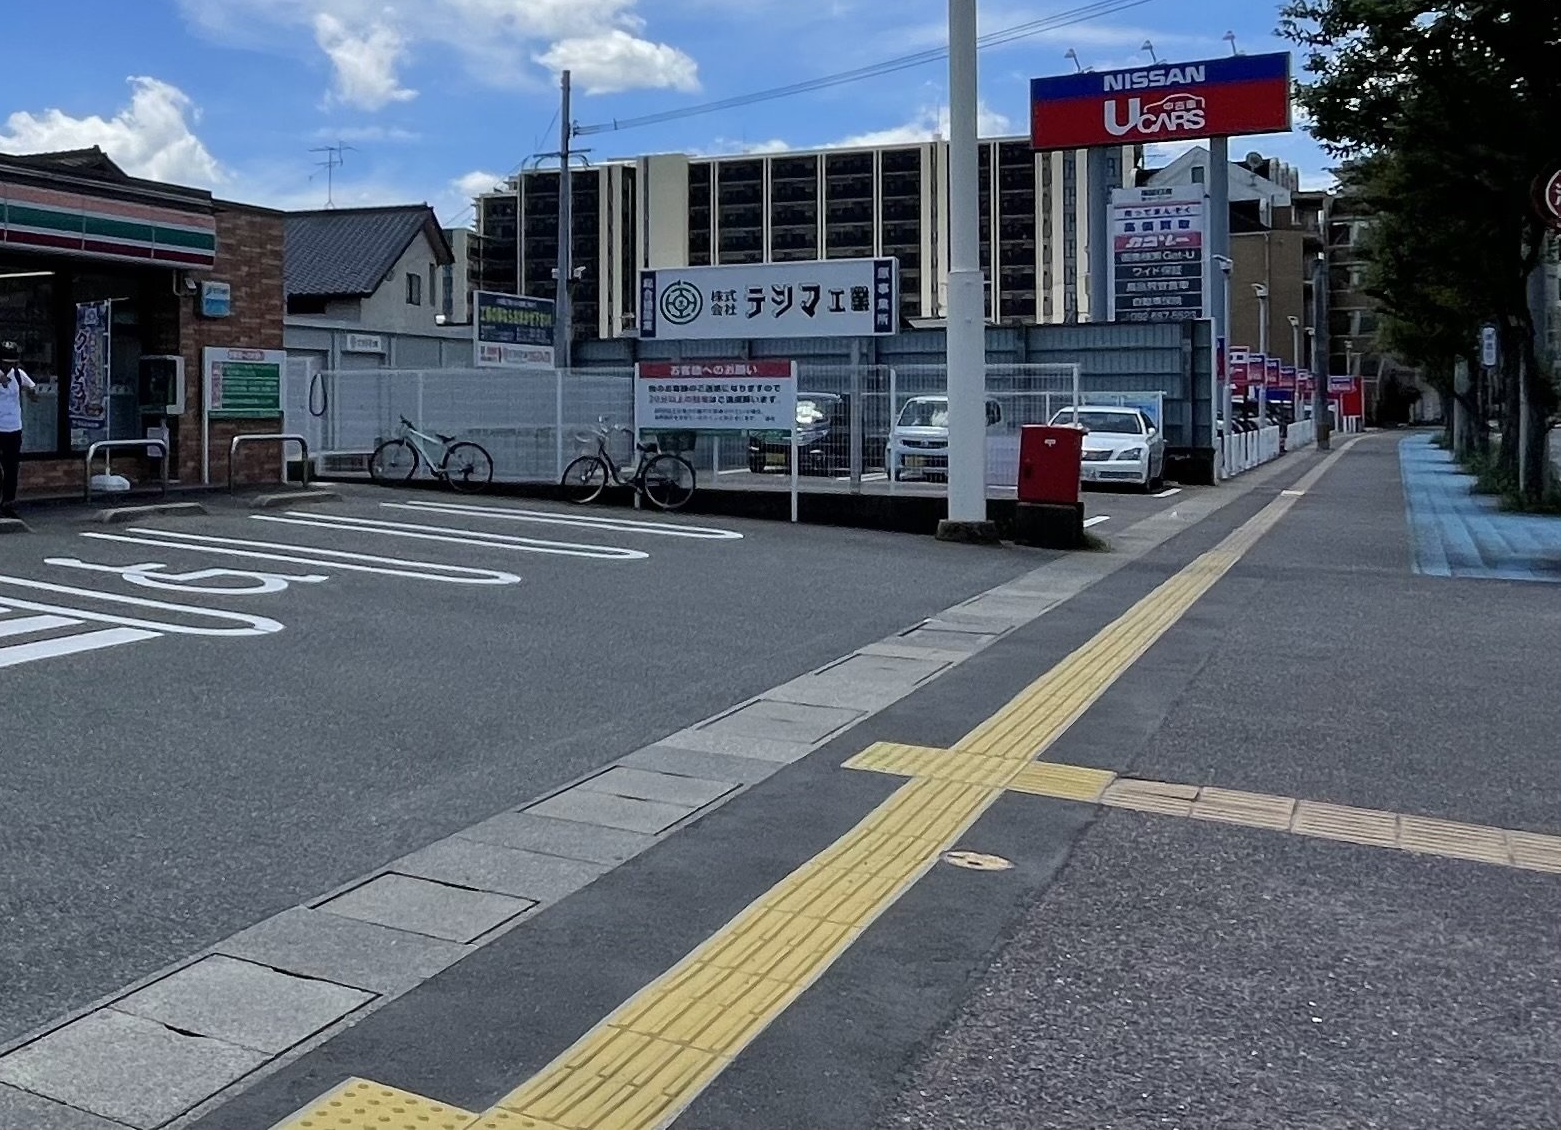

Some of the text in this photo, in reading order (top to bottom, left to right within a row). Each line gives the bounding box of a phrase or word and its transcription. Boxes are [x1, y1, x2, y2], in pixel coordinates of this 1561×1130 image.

[1103, 66, 1206, 91] NISSAN
[745, 282, 870, 319] テシマ工業
